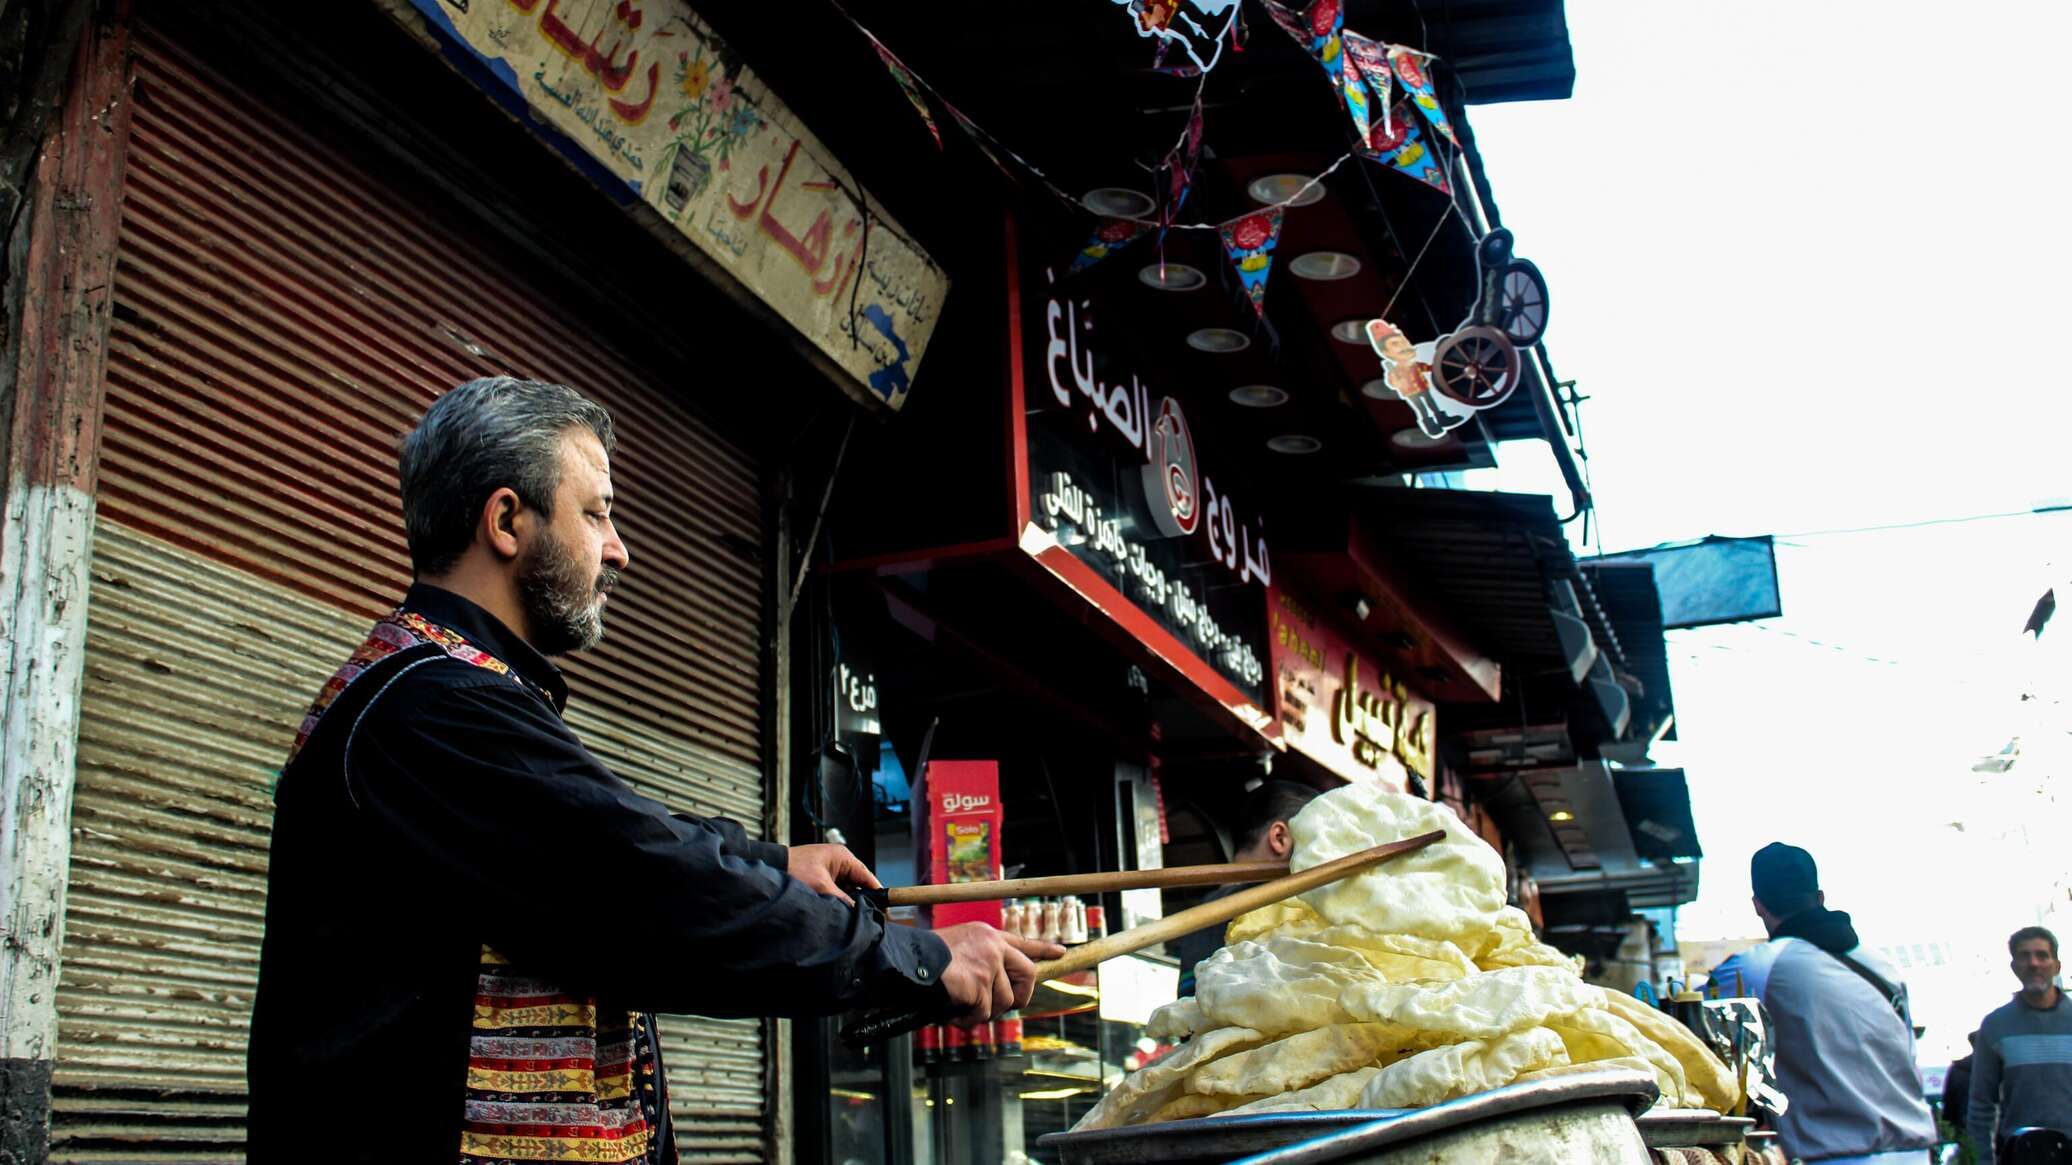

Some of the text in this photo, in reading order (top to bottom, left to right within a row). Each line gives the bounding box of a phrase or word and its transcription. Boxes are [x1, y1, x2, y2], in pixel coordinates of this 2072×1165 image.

[1085, 493, 1128, 574] جاهزة
[1204, 475, 1271, 588] فروج
[1129, 543, 1165, 605] وجبات
[1197, 604, 1220, 649] دجاج
[850, 673, 878, 713] فرع
